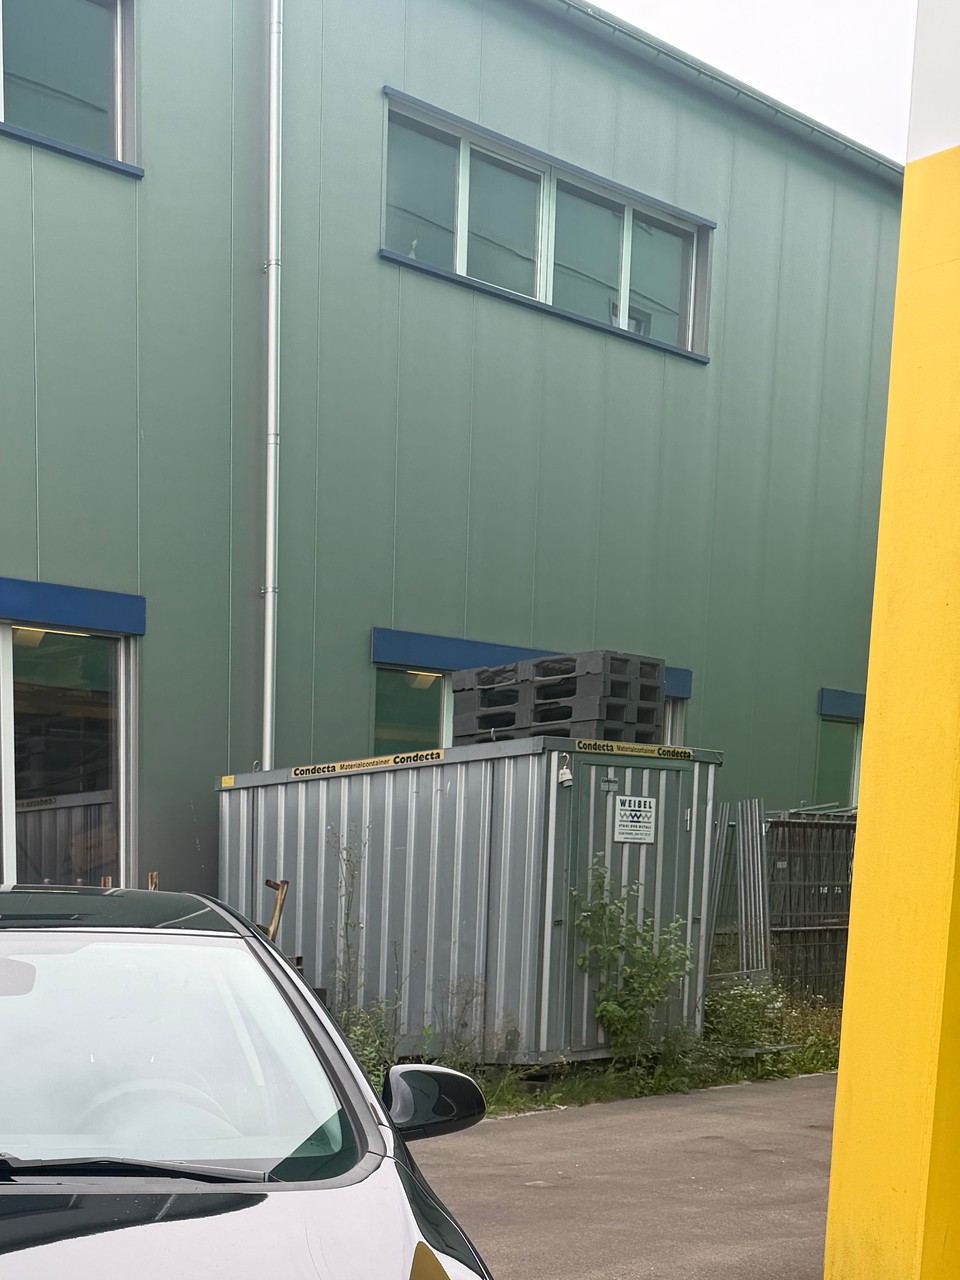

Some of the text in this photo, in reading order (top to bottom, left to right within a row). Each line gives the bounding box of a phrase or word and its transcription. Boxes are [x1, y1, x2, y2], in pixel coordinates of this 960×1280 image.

[577, 740, 691, 759] Condecta Materialcontainer Condecta
[293, 751, 441, 777] Condecta Materialcontainer Condecta
[619, 798, 653, 810] WEIBEL
